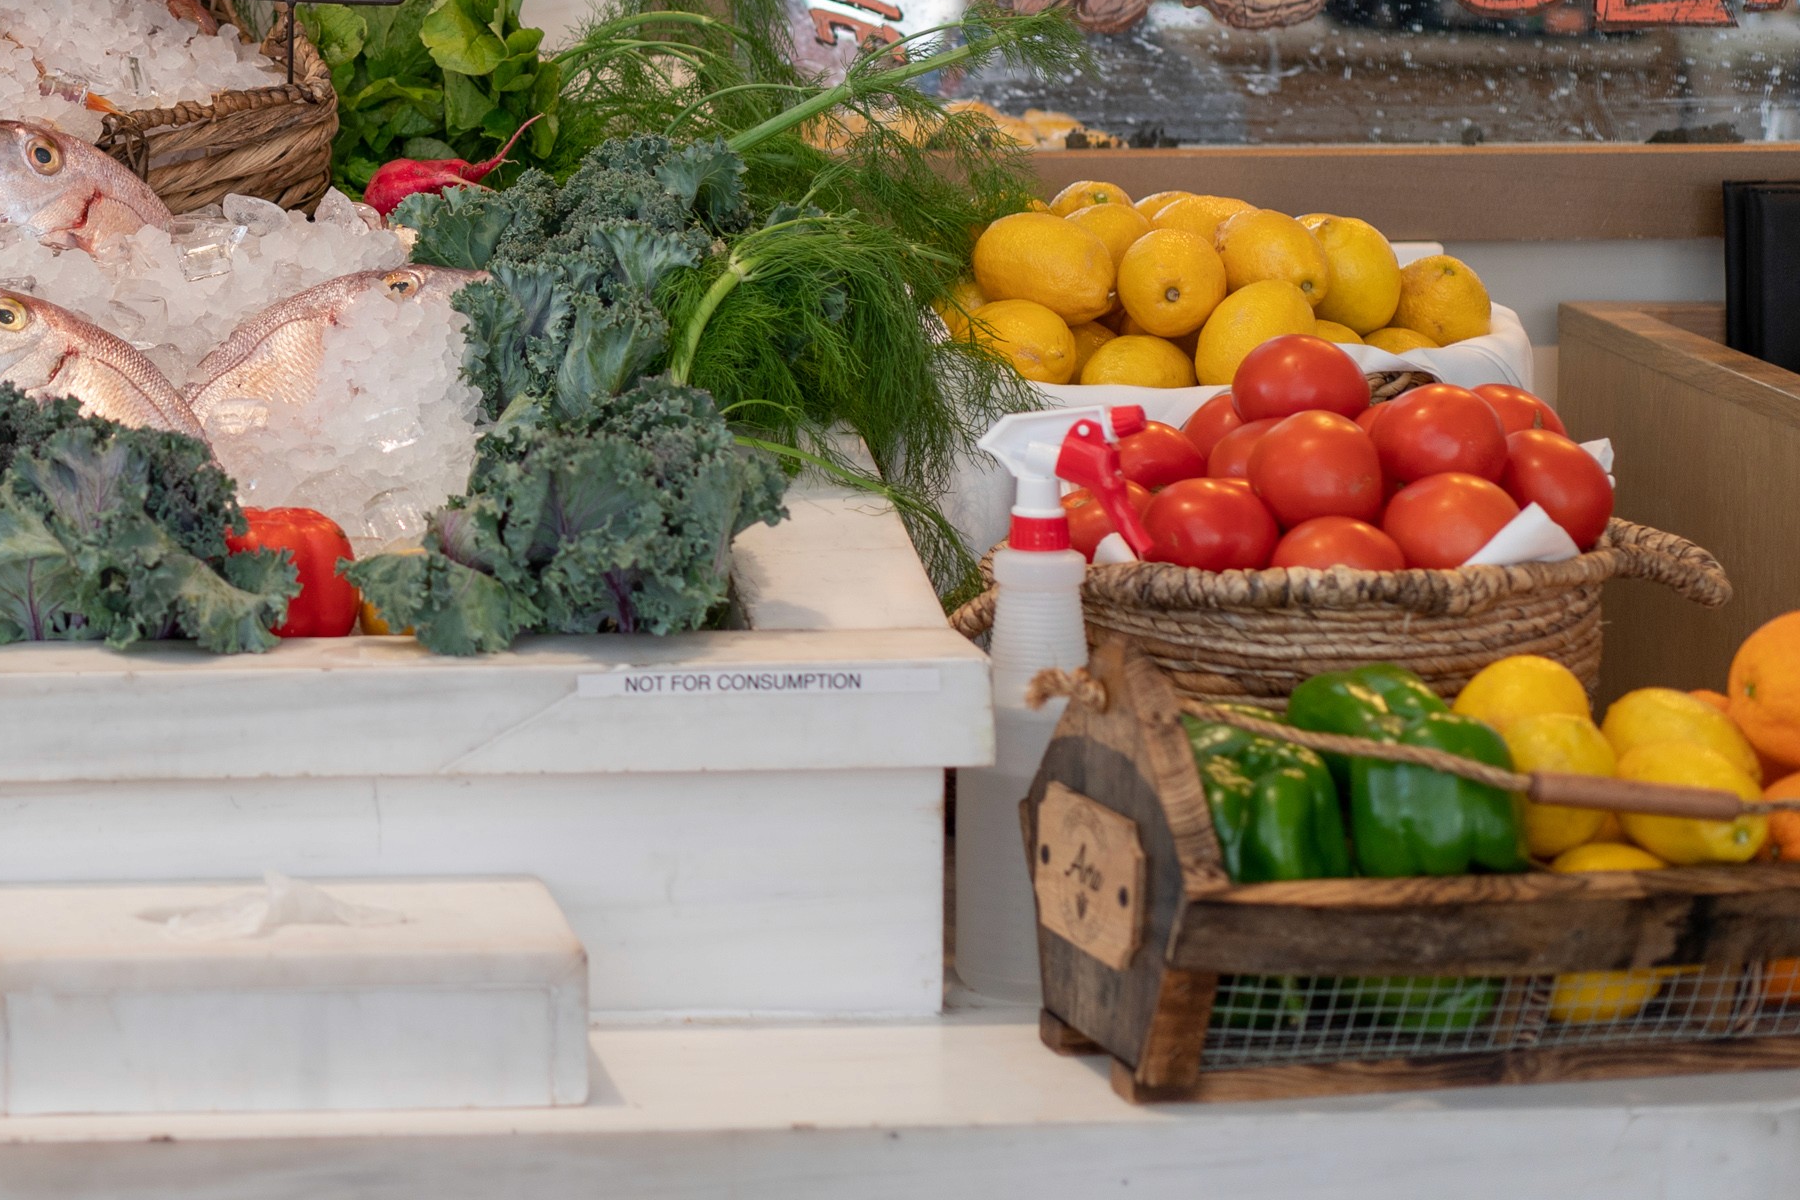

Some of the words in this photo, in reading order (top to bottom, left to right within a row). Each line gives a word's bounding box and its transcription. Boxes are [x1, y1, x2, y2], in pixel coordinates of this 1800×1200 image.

[624, 675, 665, 692] NOT
[670, 674, 711, 691] FOR
[716, 673, 862, 691] CONSUMPTION
